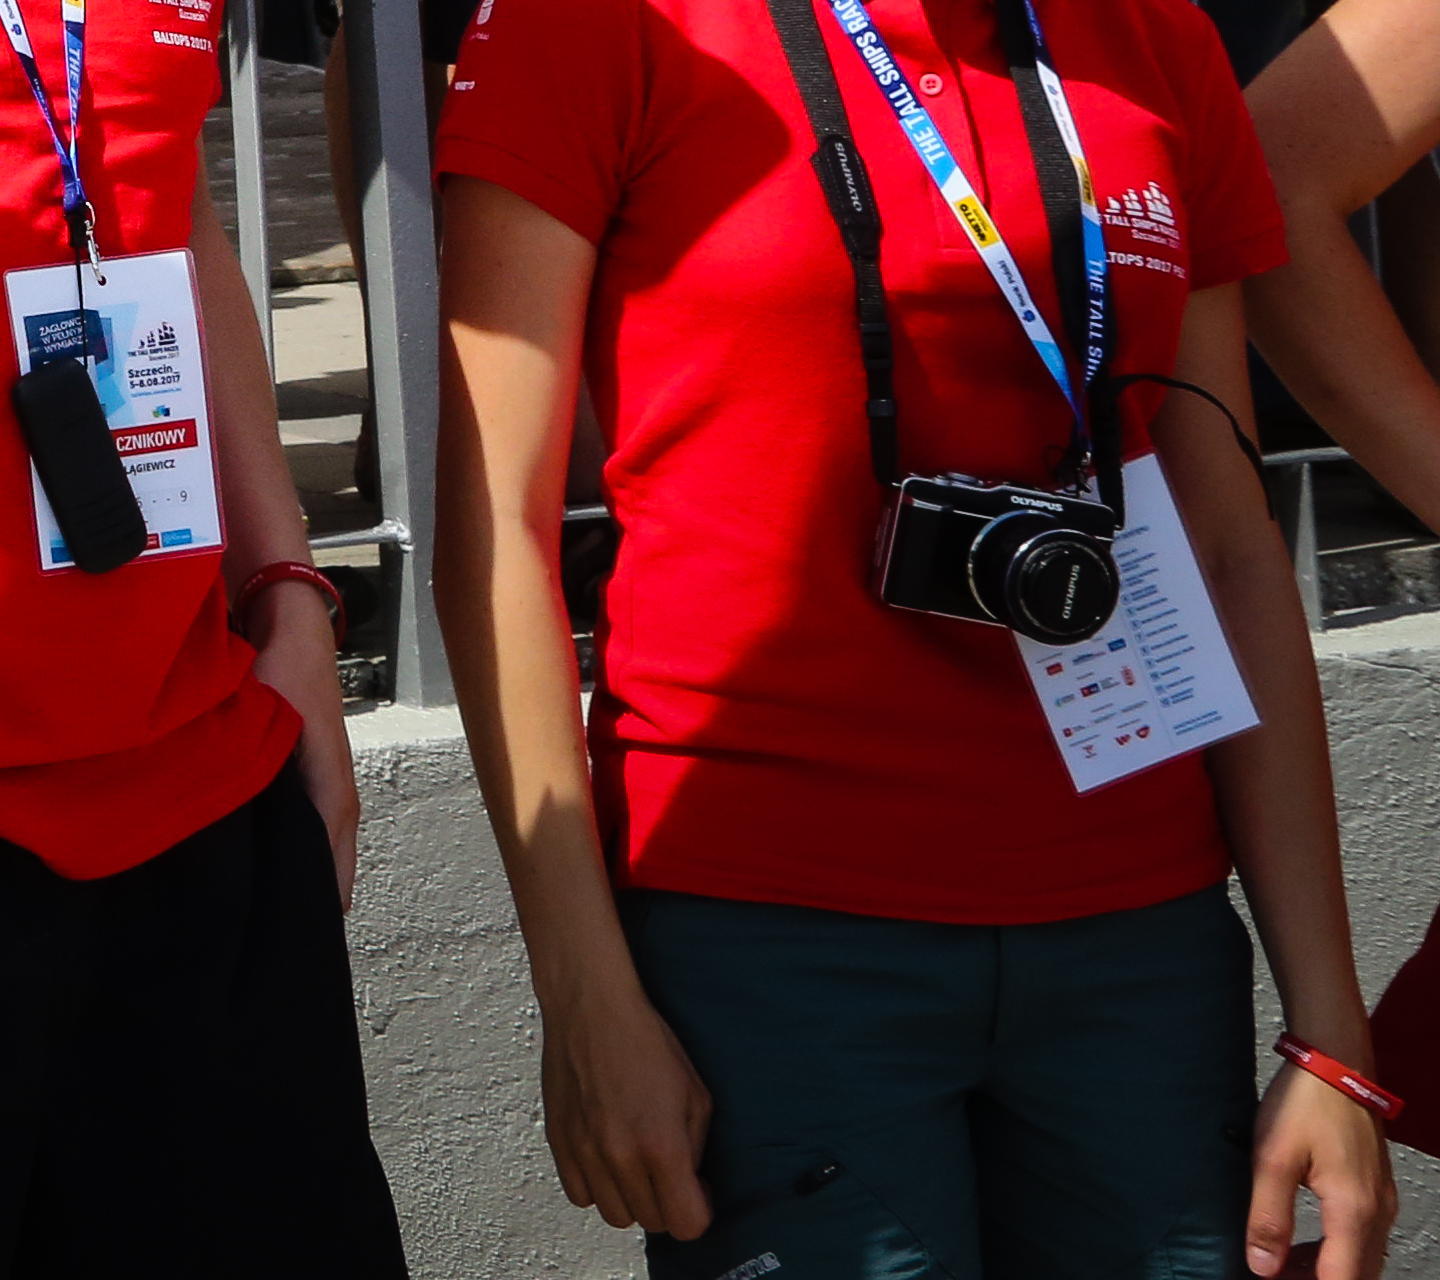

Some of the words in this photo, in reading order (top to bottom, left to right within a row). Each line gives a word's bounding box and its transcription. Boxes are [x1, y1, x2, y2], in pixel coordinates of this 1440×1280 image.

[153, 30, 191, 48] BALTOPS
[855, 29, 900, 87] SHIPS
[888, 81, 925, 122] TALL
[914, 122, 946, 166] THE
[833, 141, 863, 214] OLYMPUS
[959, 203, 986, 240] NETTO
[1103, 213, 1131, 228] TALL
[1089, 259, 1104, 294] THE
[1145, 256, 1172, 274] 2017
[1089, 298, 1104, 340] TALL
[116, 427, 187, 452] CZNIKOWY
[1010, 494, 1064, 512] OLYMPUS
[1061, 563, 1081, 620] OLYMPUS
